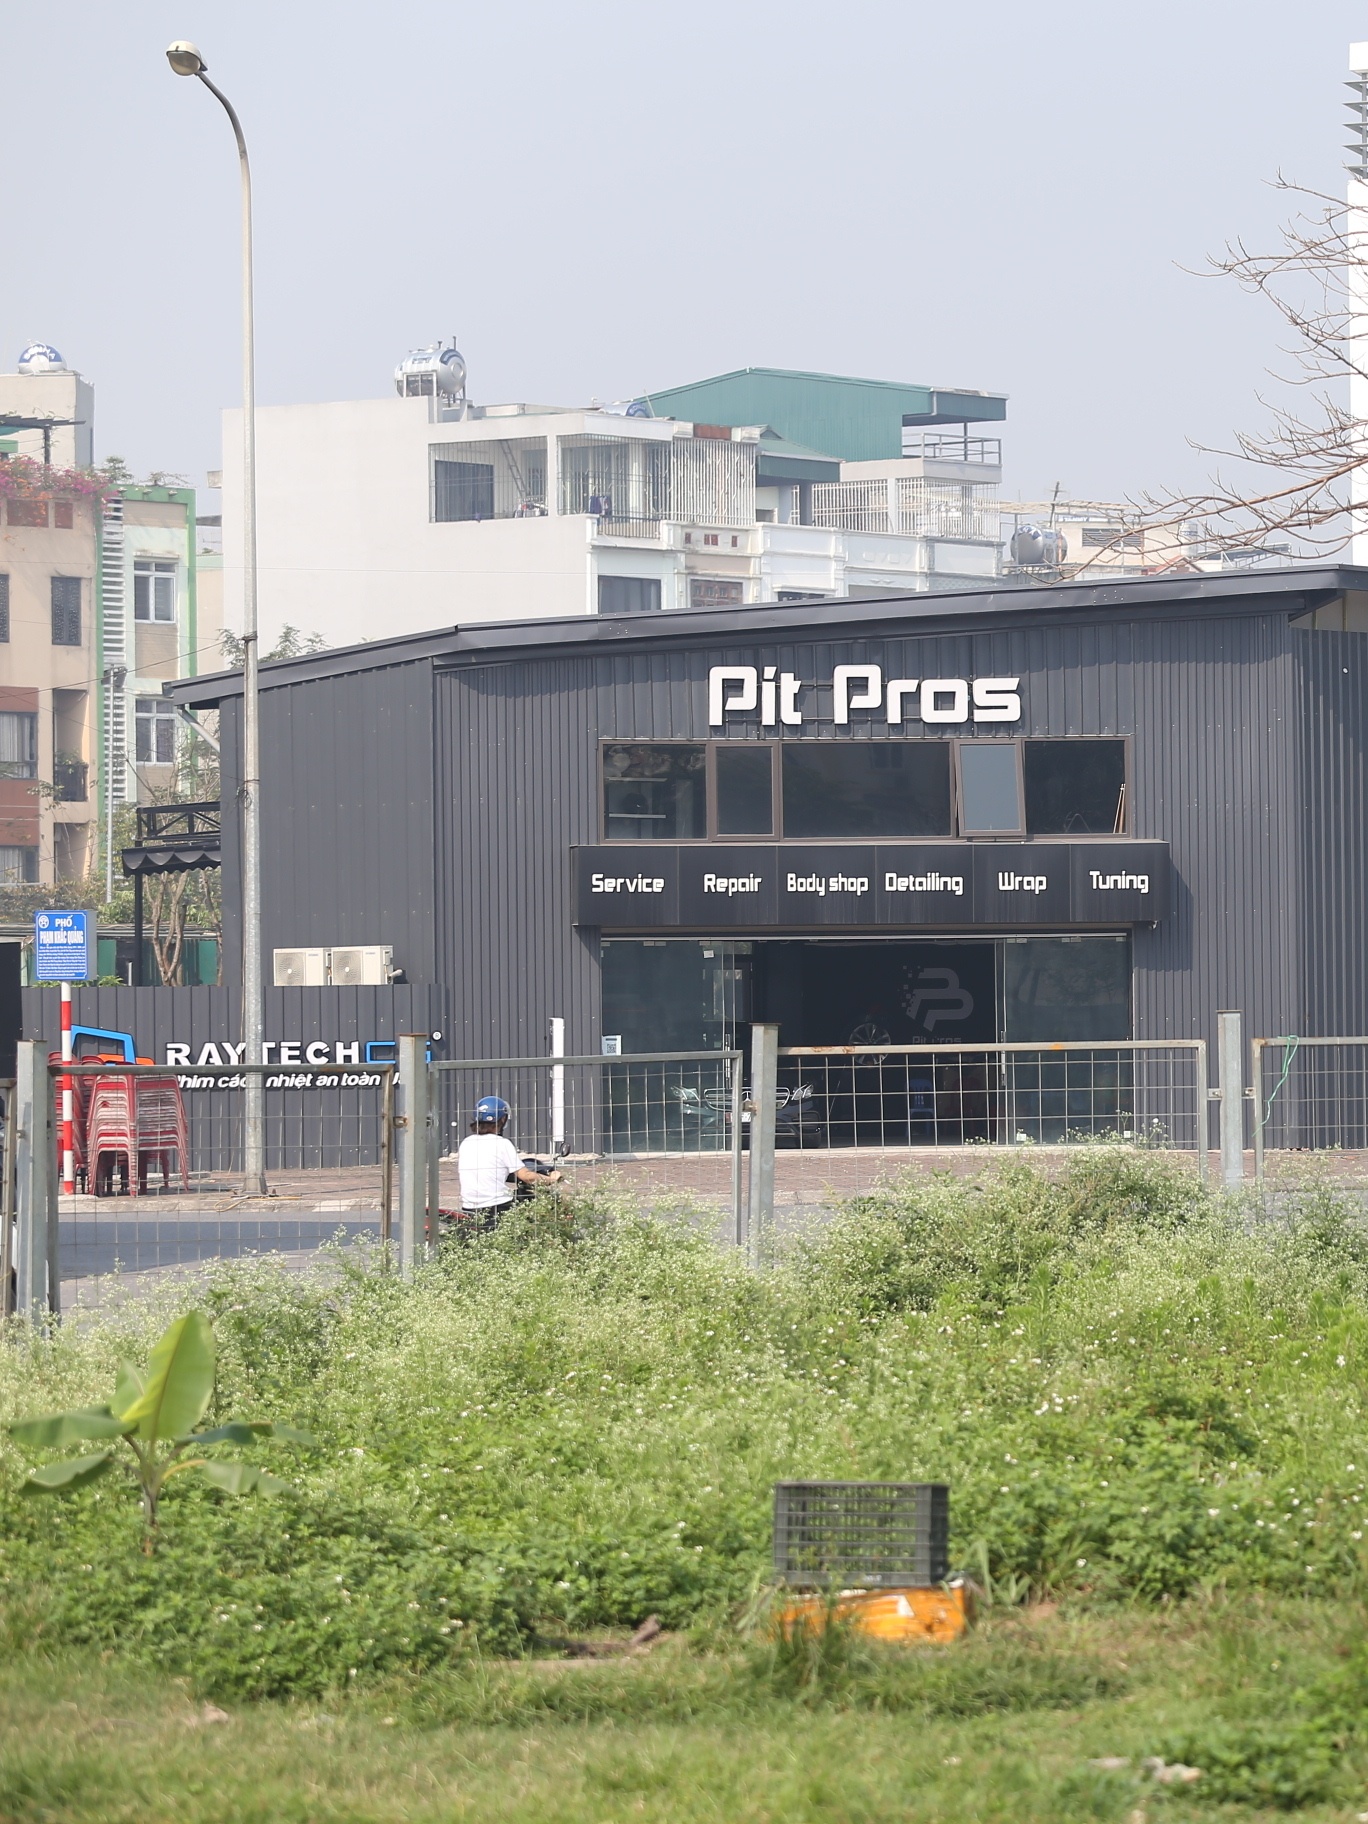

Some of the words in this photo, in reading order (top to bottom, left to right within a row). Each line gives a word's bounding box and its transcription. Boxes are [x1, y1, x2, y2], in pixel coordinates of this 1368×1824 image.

[708, 665, 802, 726] Pit
[833, 664, 1022, 725] Pros
[591, 872, 665, 893] Service
[703, 872, 763, 897] Repair
[787, 872, 826, 897] Body
[828, 872, 869, 896] shop
[885, 872, 964, 896] Detailing
[998, 872, 1048, 895] Wrap
[1089, 869, 1150, 894] Tuning
[55, 915, 74, 928] PHỐ
[178, 1073, 215, 1089] him
[265, 1073, 313, 1089] nhiệt
[316, 1075, 339, 1087] an
[341, 1072, 381, 1087] toàn
